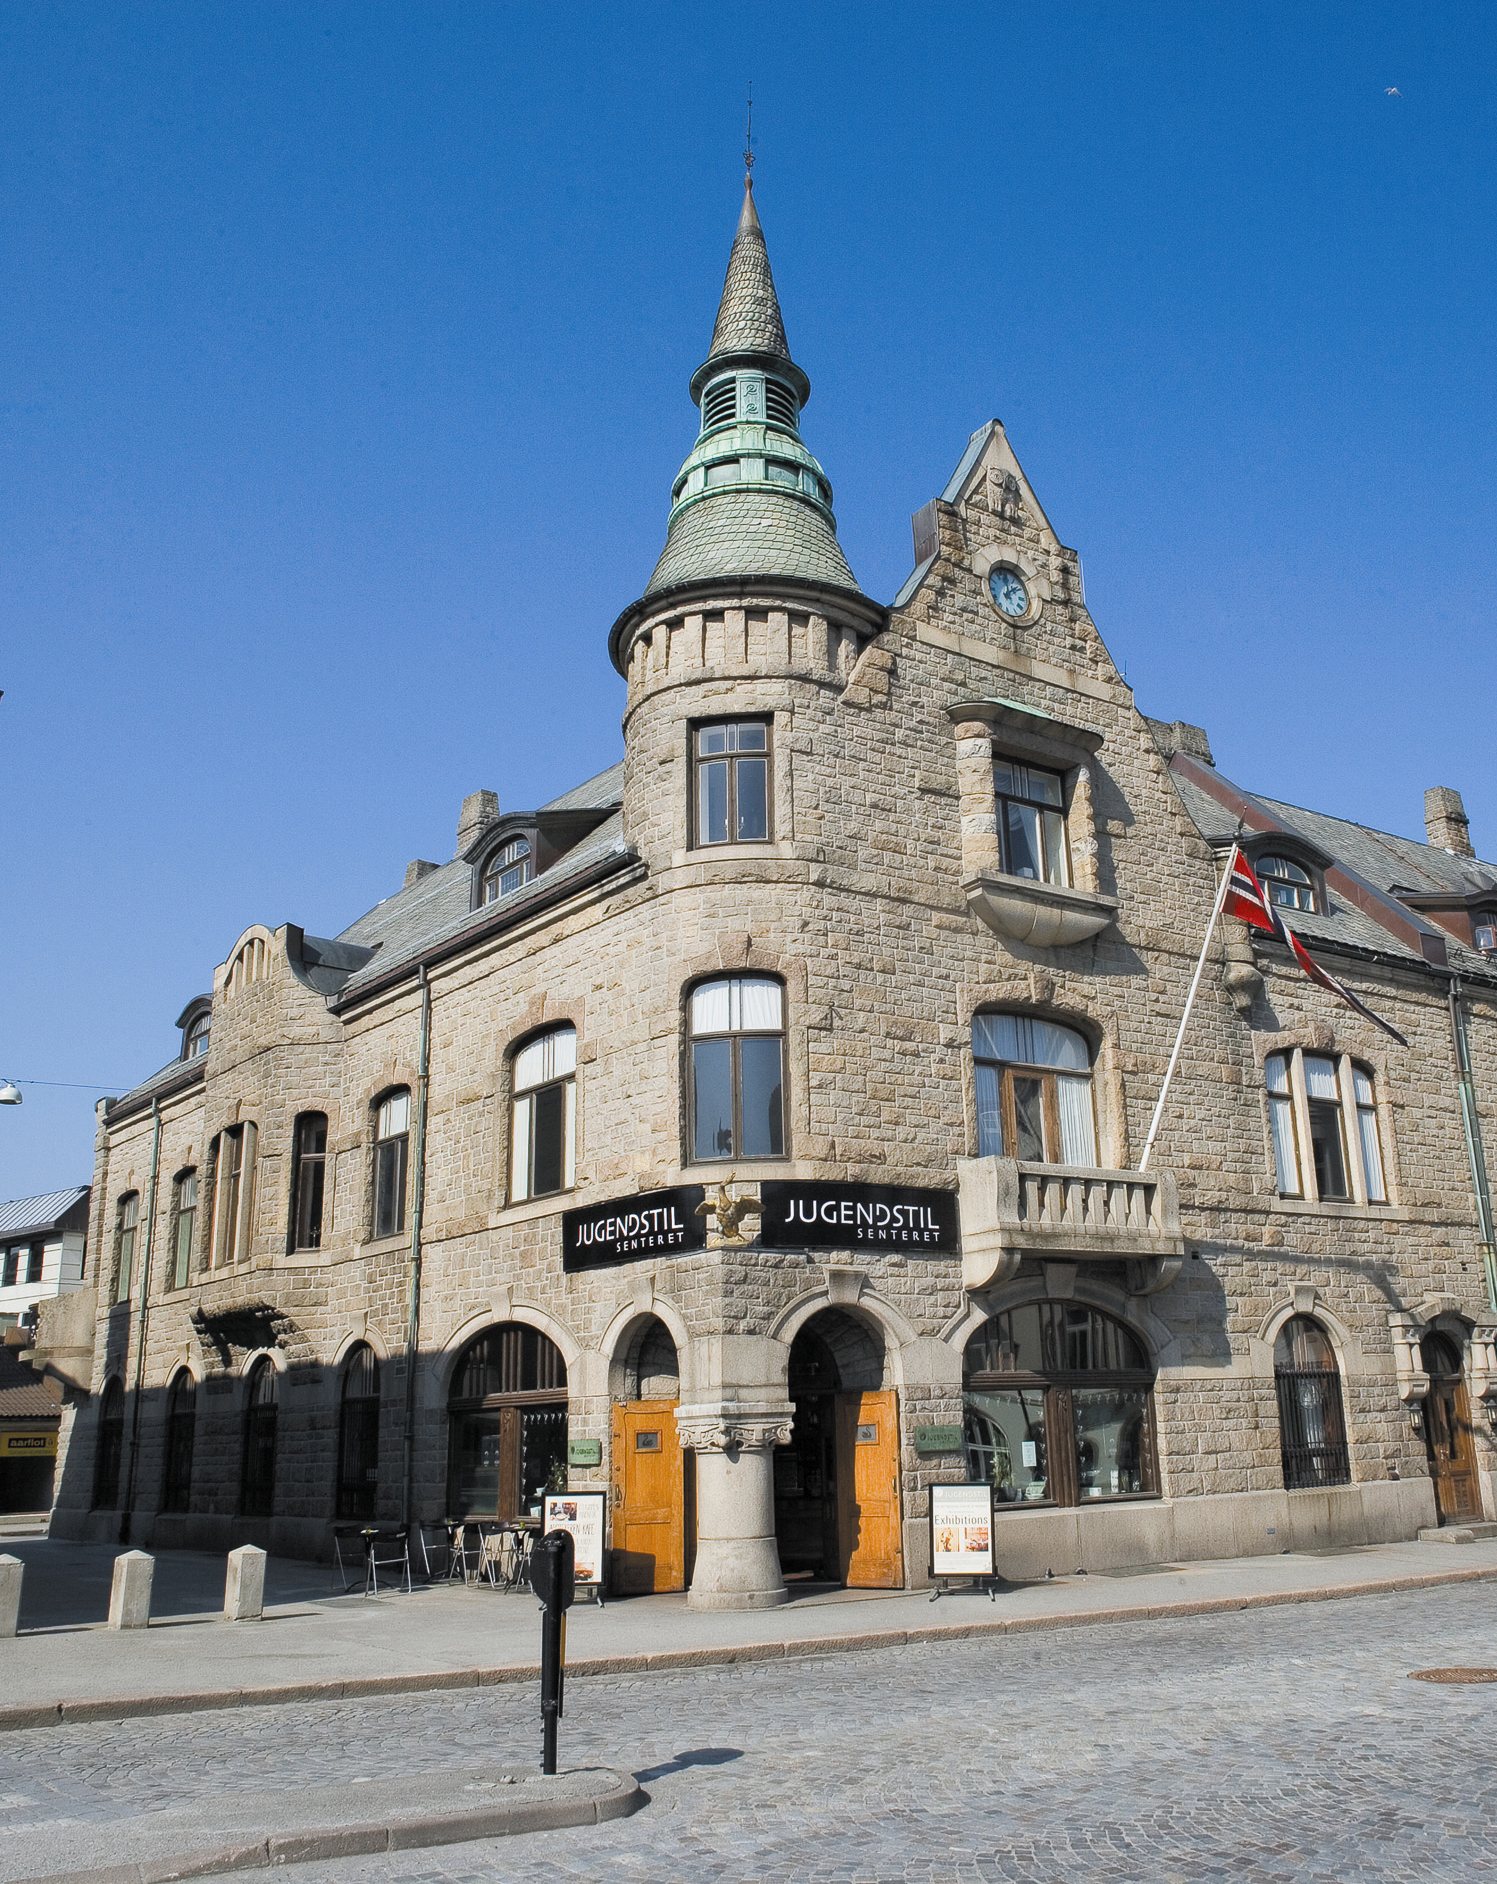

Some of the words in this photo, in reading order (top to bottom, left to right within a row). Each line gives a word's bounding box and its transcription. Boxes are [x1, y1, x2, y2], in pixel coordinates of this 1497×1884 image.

[785, 1200, 939, 1229] JUGENDSTIL
[576, 1207, 684, 1247] JUGENDSTIL
[857, 1228, 940, 1241] SENTERET
[616, 1232, 684, 1252] SENTERET
[934, 1514, 989, 1525] Exhibitions
